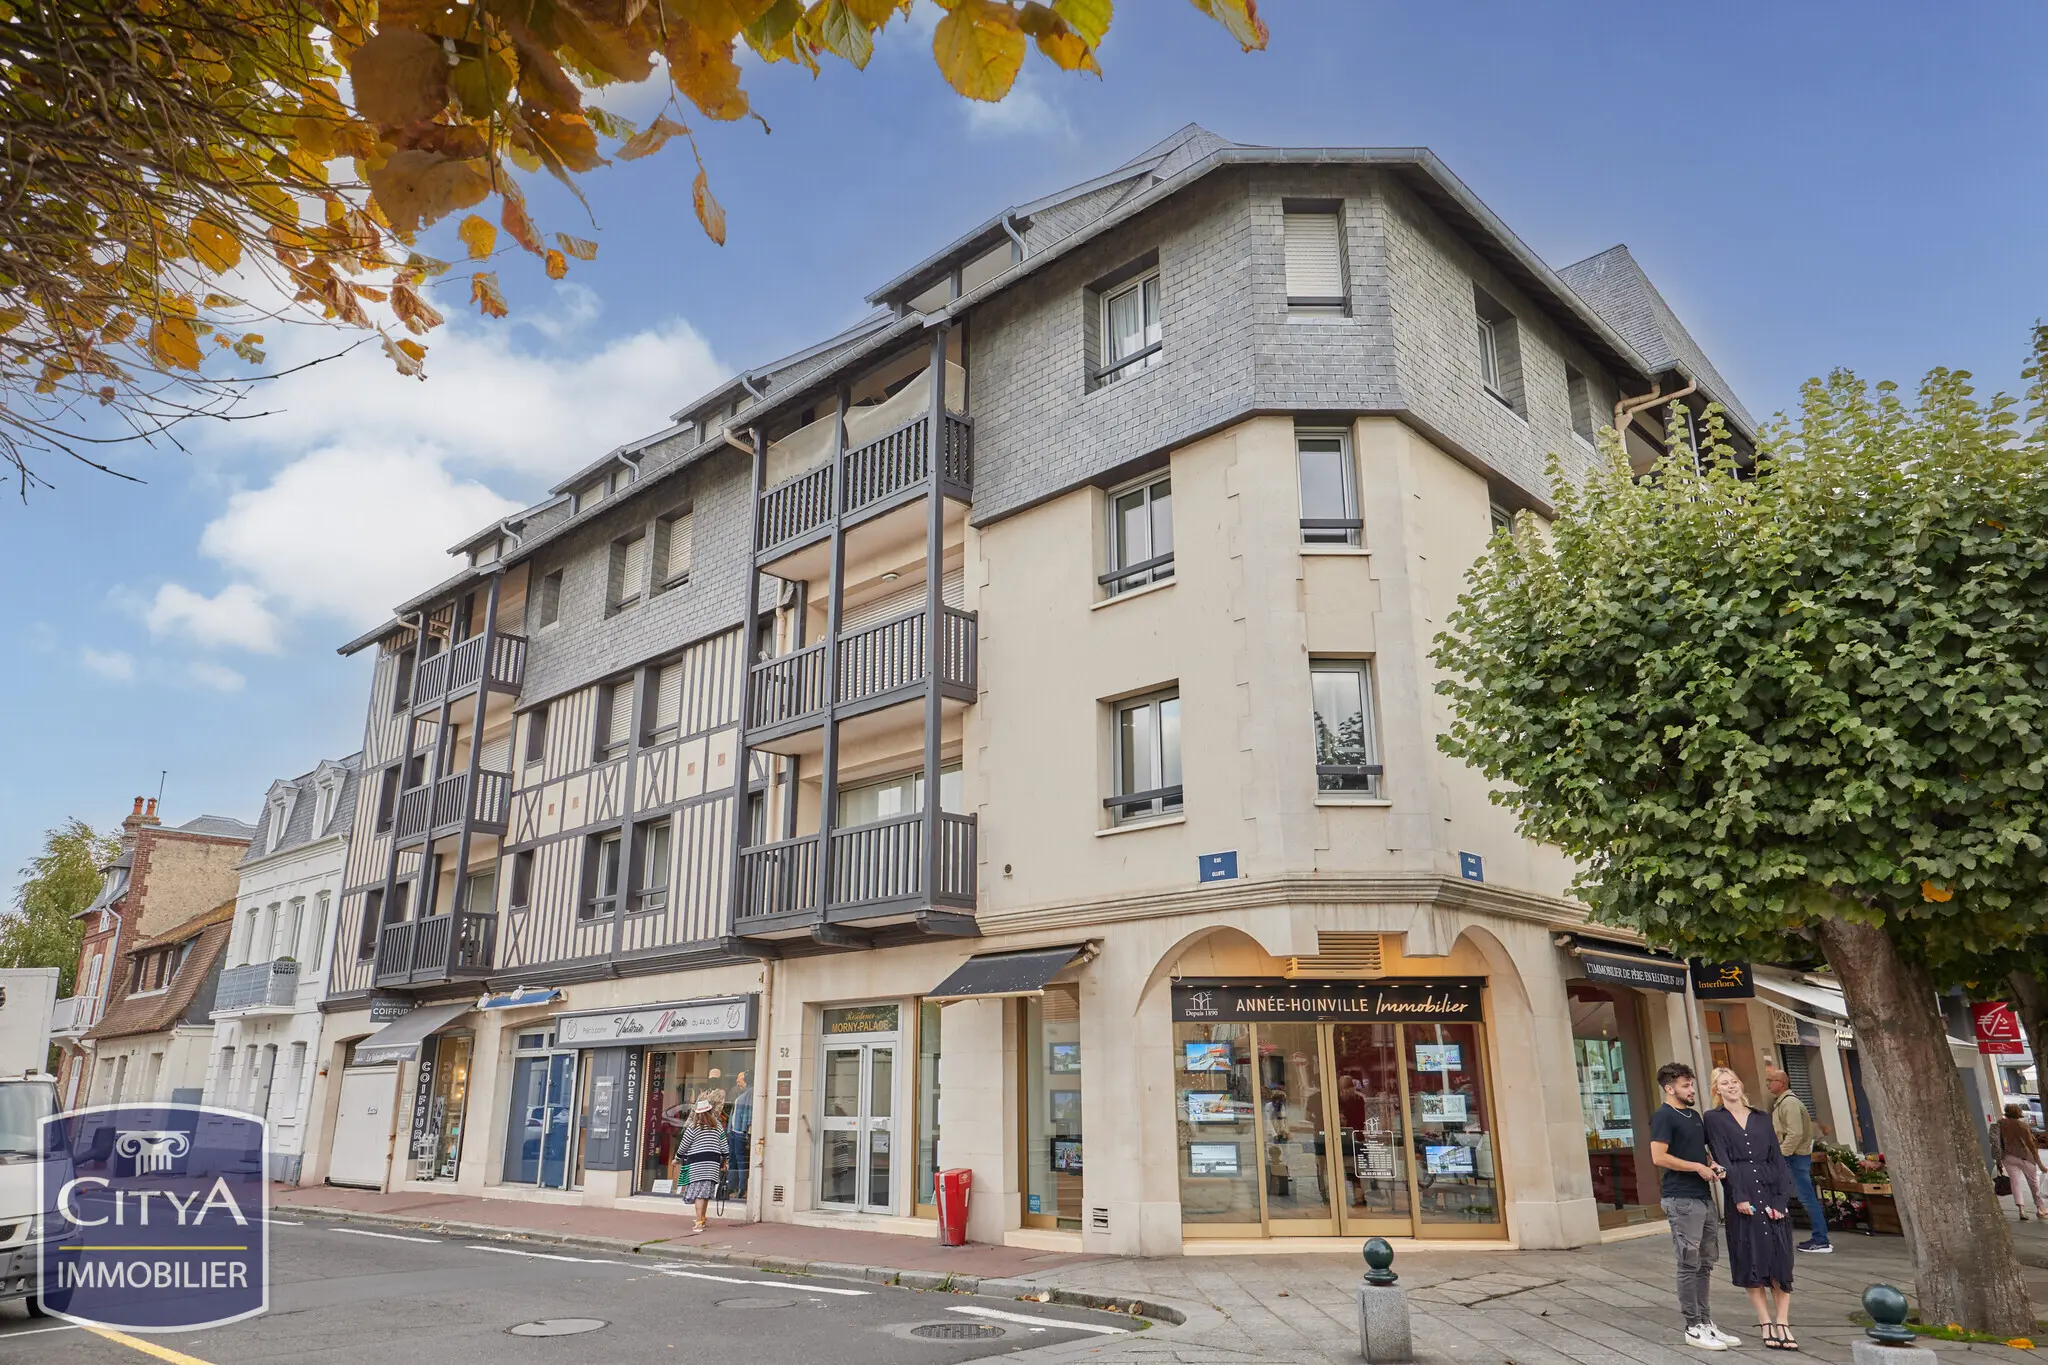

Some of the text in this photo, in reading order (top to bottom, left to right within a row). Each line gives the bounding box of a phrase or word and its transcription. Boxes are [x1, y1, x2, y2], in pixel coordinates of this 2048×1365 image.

[1586, 962, 1623, 978] L'IMMOBILIER
[1622, 968, 1632, 979] DE
[1630, 968, 1645, 981] PÈRE
[1644, 972, 1652, 981] EN
[1698, 979, 1735, 988] Interflora
[1236, 992, 1469, 1015] ANNÉE-HOINVILLE Immobilier
[650, 1010, 688, 1033] Marie
[1185, 1010, 1204, 1018] Depuis
[831, 1019, 889, 1032] MORNY-PALACE
[780, 1047, 790, 1058] 52
[623, 1053, 638, 1158] GRANDES TAILLES
